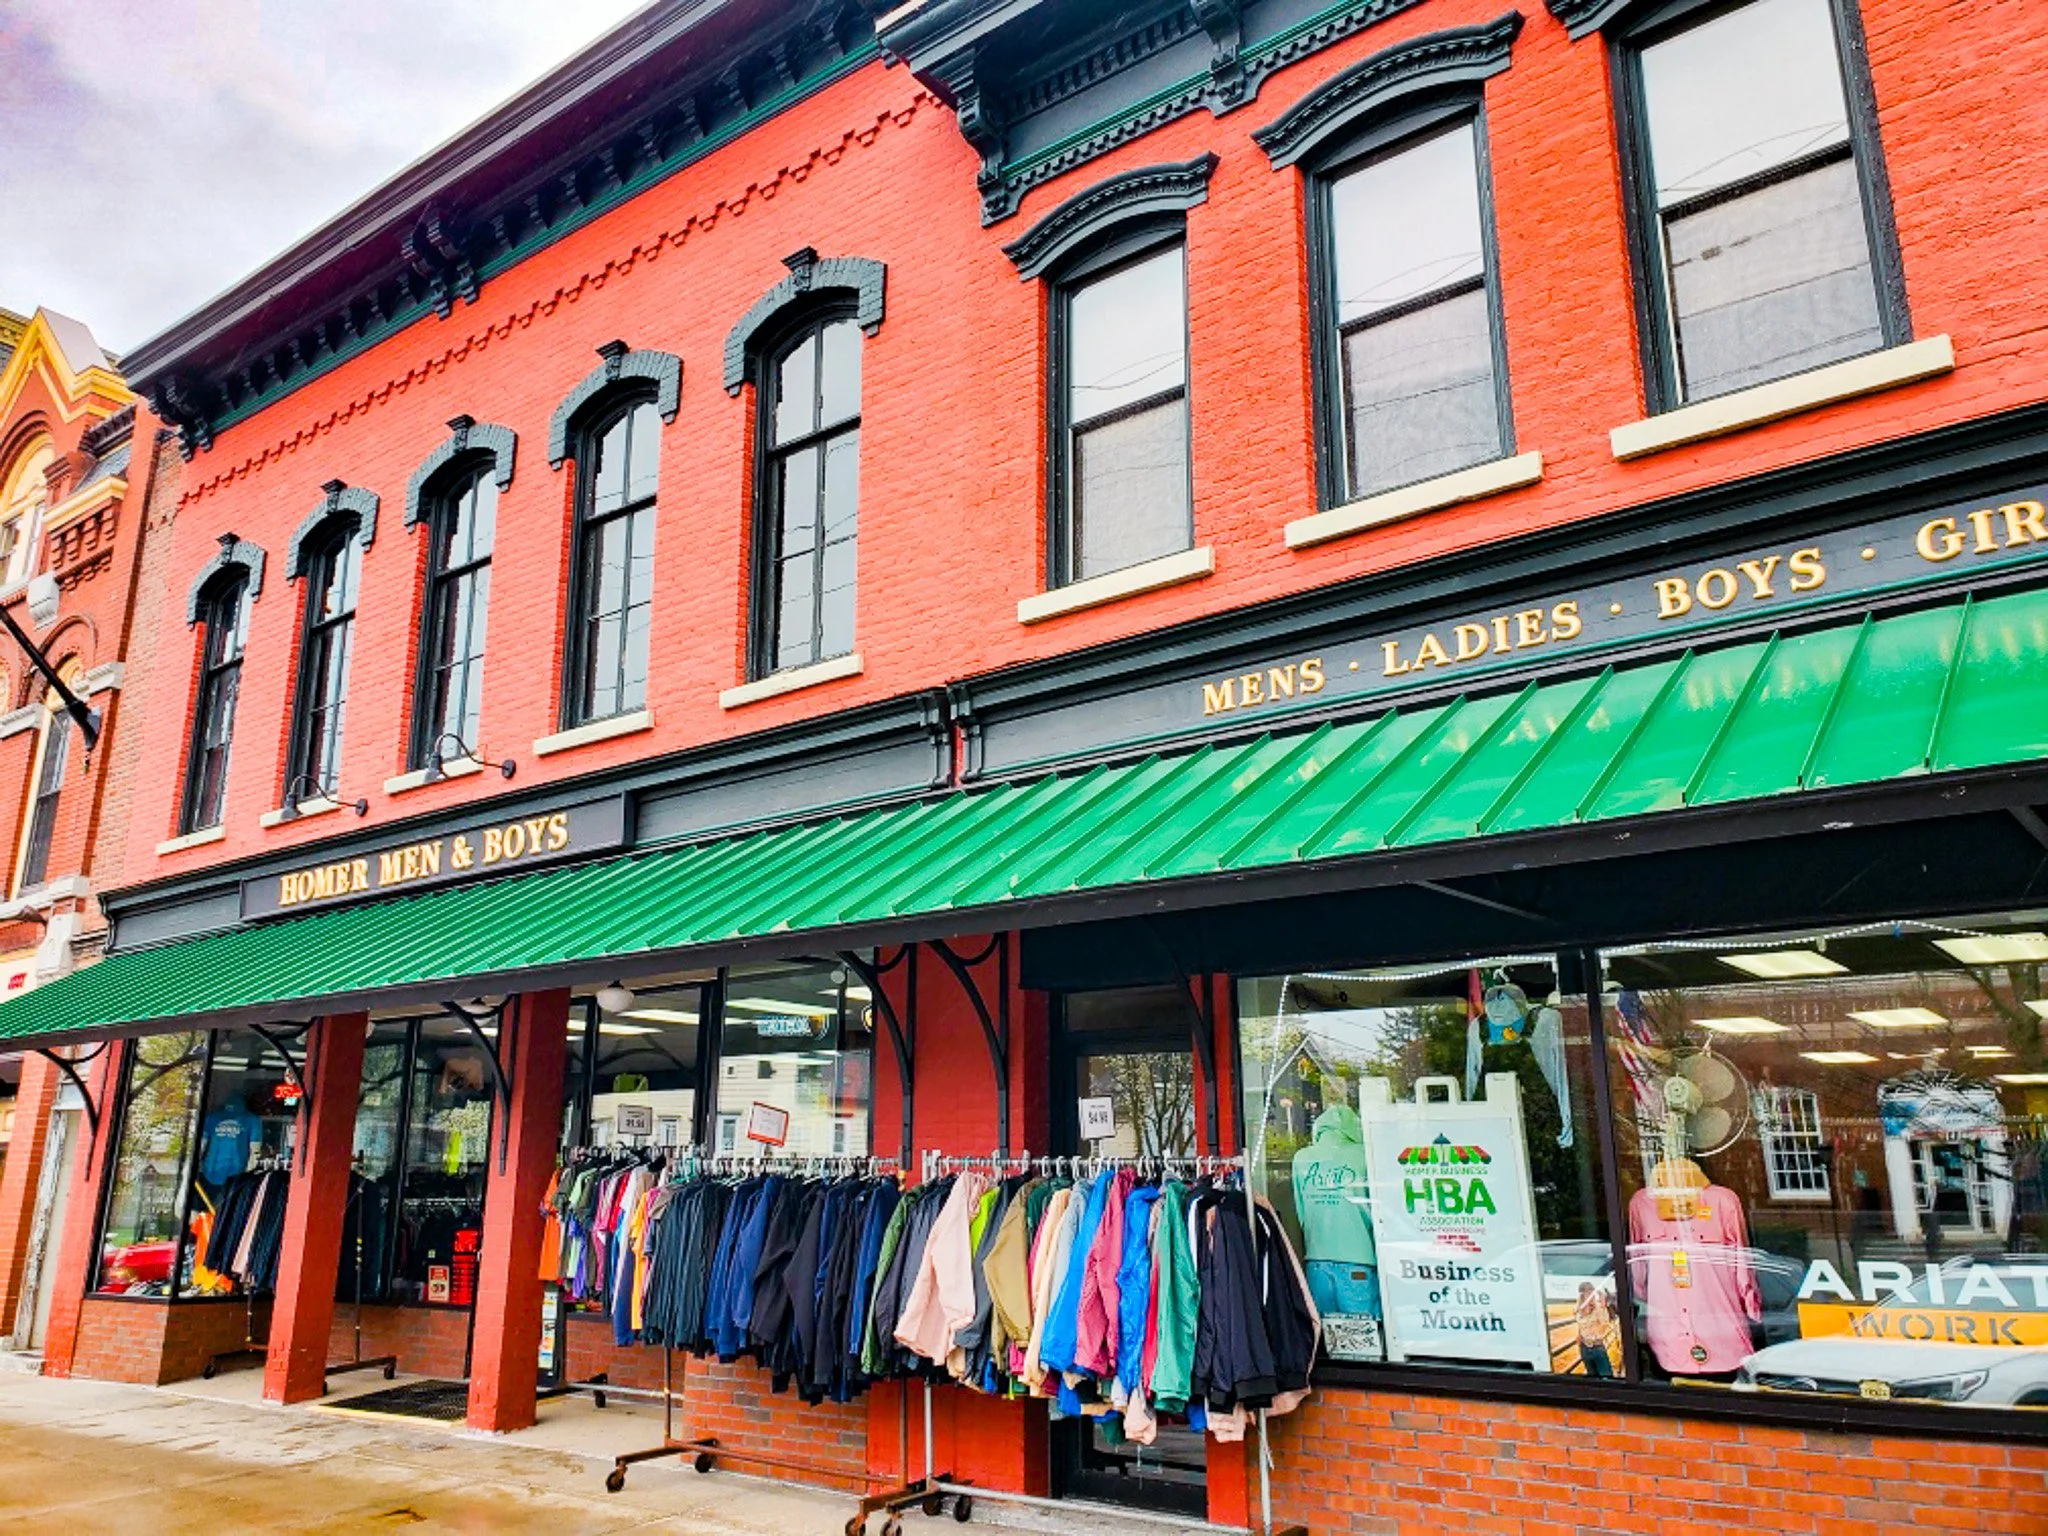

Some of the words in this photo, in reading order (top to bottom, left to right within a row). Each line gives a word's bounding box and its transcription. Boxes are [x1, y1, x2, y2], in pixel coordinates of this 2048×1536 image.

[1202, 658, 1326, 716] MENS
[1381, 600, 1583, 677] LADIES
[1652, 546, 1827, 619] BOYS
[278, 858, 369, 905] HOMER
[379, 840, 443, 886] MEN
[450, 836, 474, 869] &
[482, 812, 570, 863] BOYS
[1404, 1178, 1496, 1214] HBA
[1400, 1259, 1515, 1282] Business
[1429, 1286, 1450, 1304] of
[1456, 1288, 1490, 1305] the
[1420, 1308, 1506, 1332] Month
[1849, 1312, 2024, 1345] WORK
